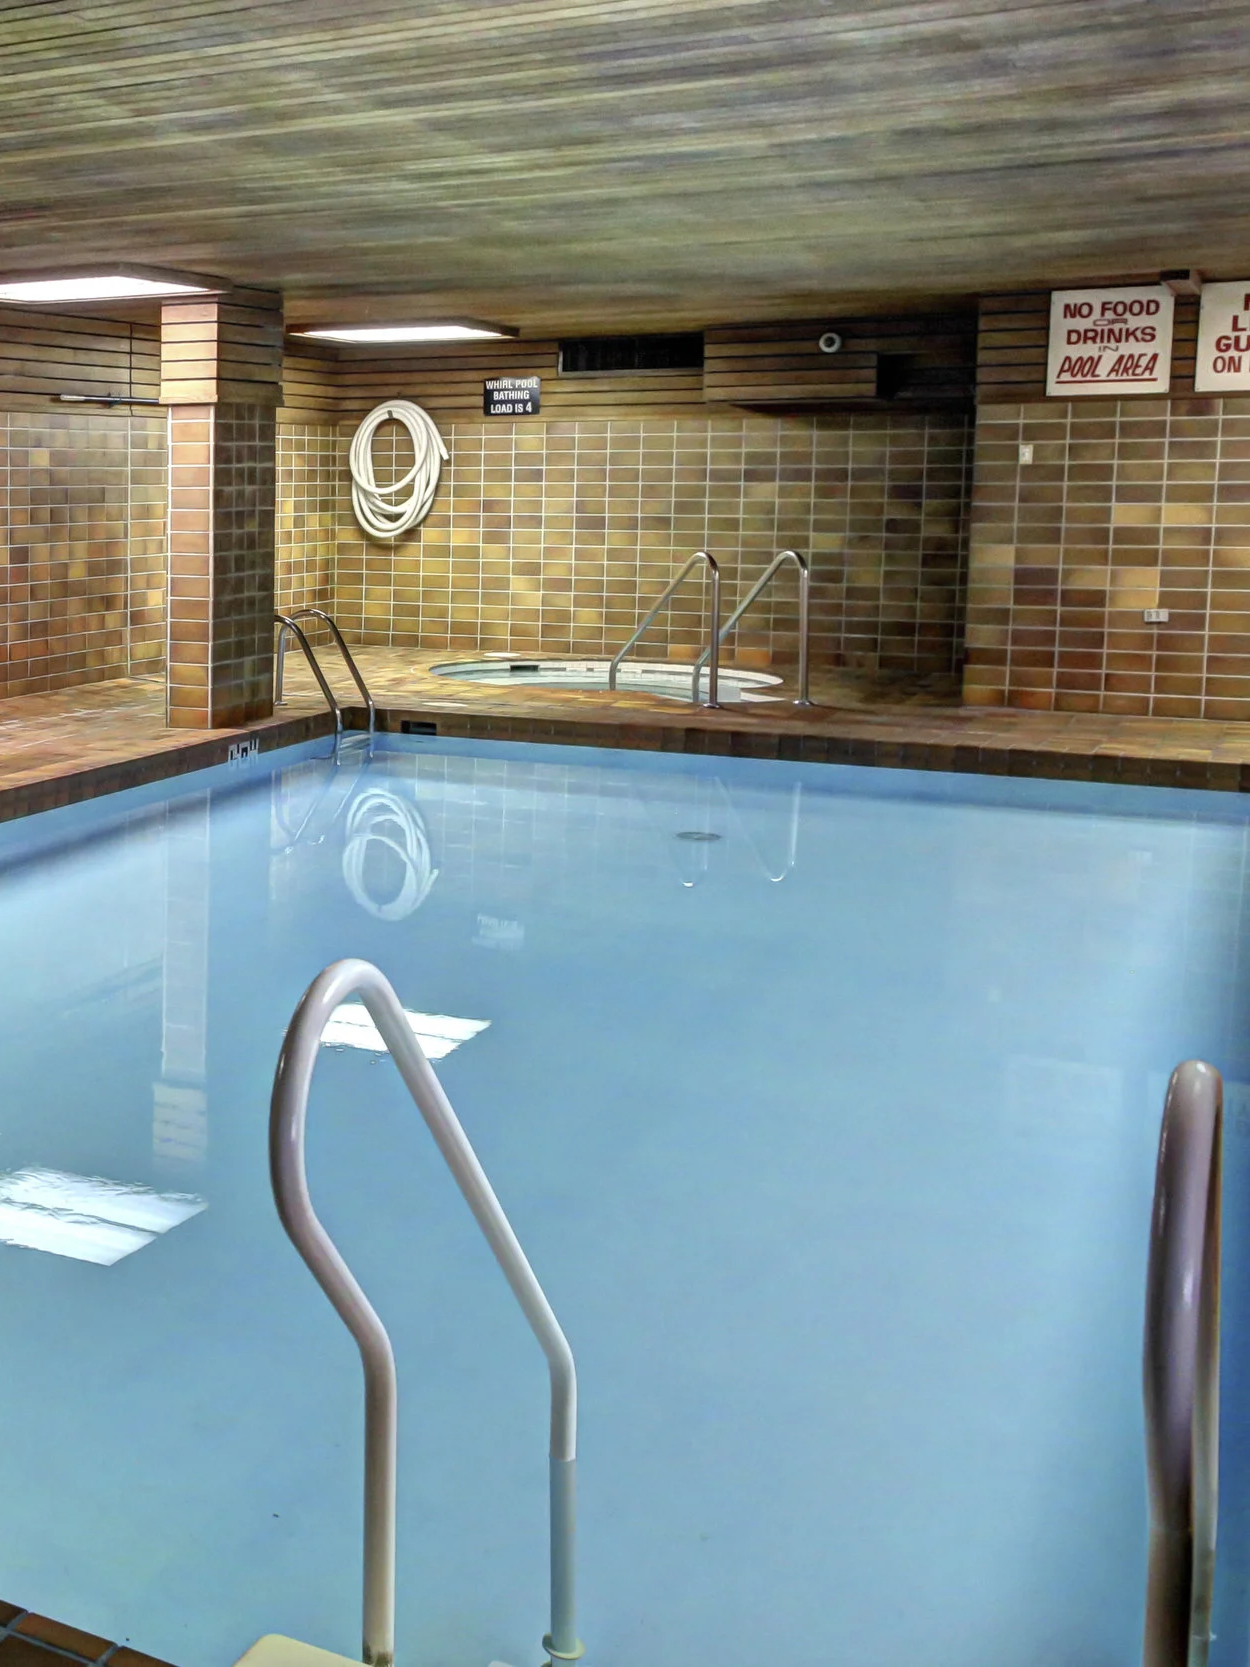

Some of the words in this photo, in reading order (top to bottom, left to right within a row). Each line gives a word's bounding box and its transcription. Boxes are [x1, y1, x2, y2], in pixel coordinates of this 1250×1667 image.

[1063, 302, 1093, 319] NO
[1101, 299, 1160, 317] FOOD
[1093, 318, 1128, 327] OR
[1066, 325, 1157, 345] DRINKS
[1098, 345, 1119, 353] IN
[1056, 354, 1102, 379] POOL
[1107, 352, 1159, 377] AREA
[1212, 355, 1242, 374] ON
[485, 380, 513, 390] WHIRL
[515, 379, 538, 388] POOL
[493, 390, 530, 401] BATHING
[490, 404, 513, 414] LOAD
[514, 403, 524, 413] IS
[525, 401, 532, 413] 4
